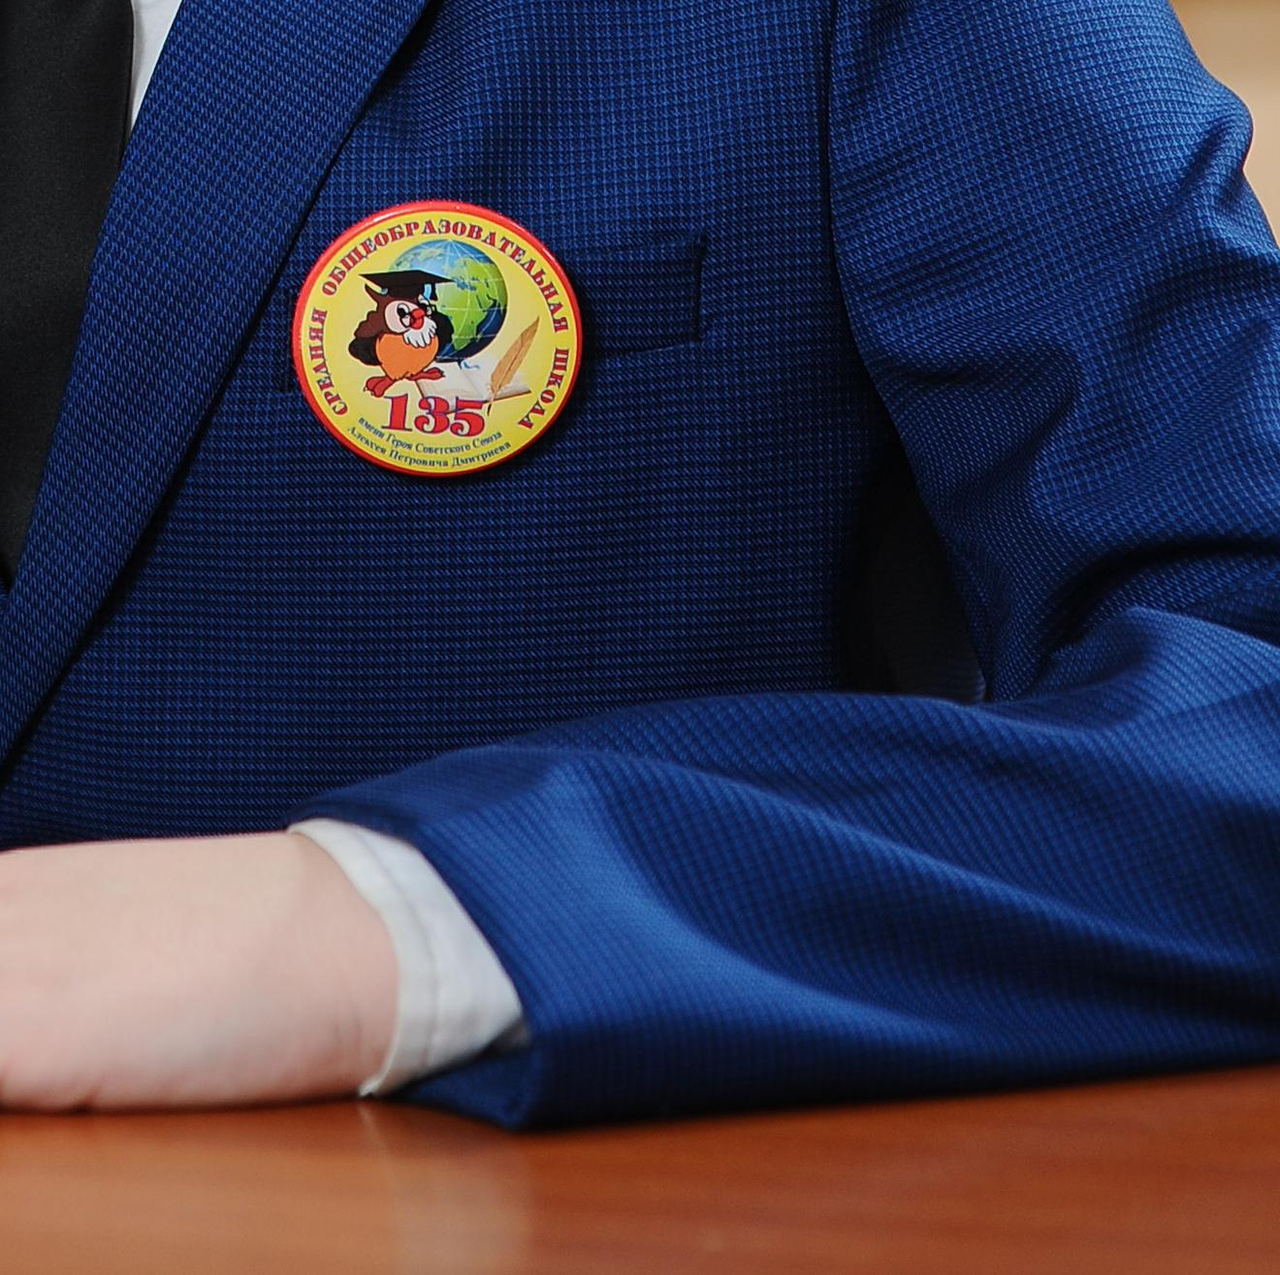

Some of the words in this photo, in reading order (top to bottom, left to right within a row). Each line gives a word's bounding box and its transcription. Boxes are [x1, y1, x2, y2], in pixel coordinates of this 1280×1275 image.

[322, 218, 569, 333] ОБЩЕОБРАЗОВАТЕЛЬНАЯ
[307, 309, 348, 416] СРЕДНЯЯ
[517, 347, 569, 430] ШКОЛА
[381, 393, 485, 437] 135
[386, 433, 412, 450] Героя
[415, 442, 470, 455] Советского
[389, 449, 448, 467] Петровича
[452, 441, 512, 468] Дмитриева
